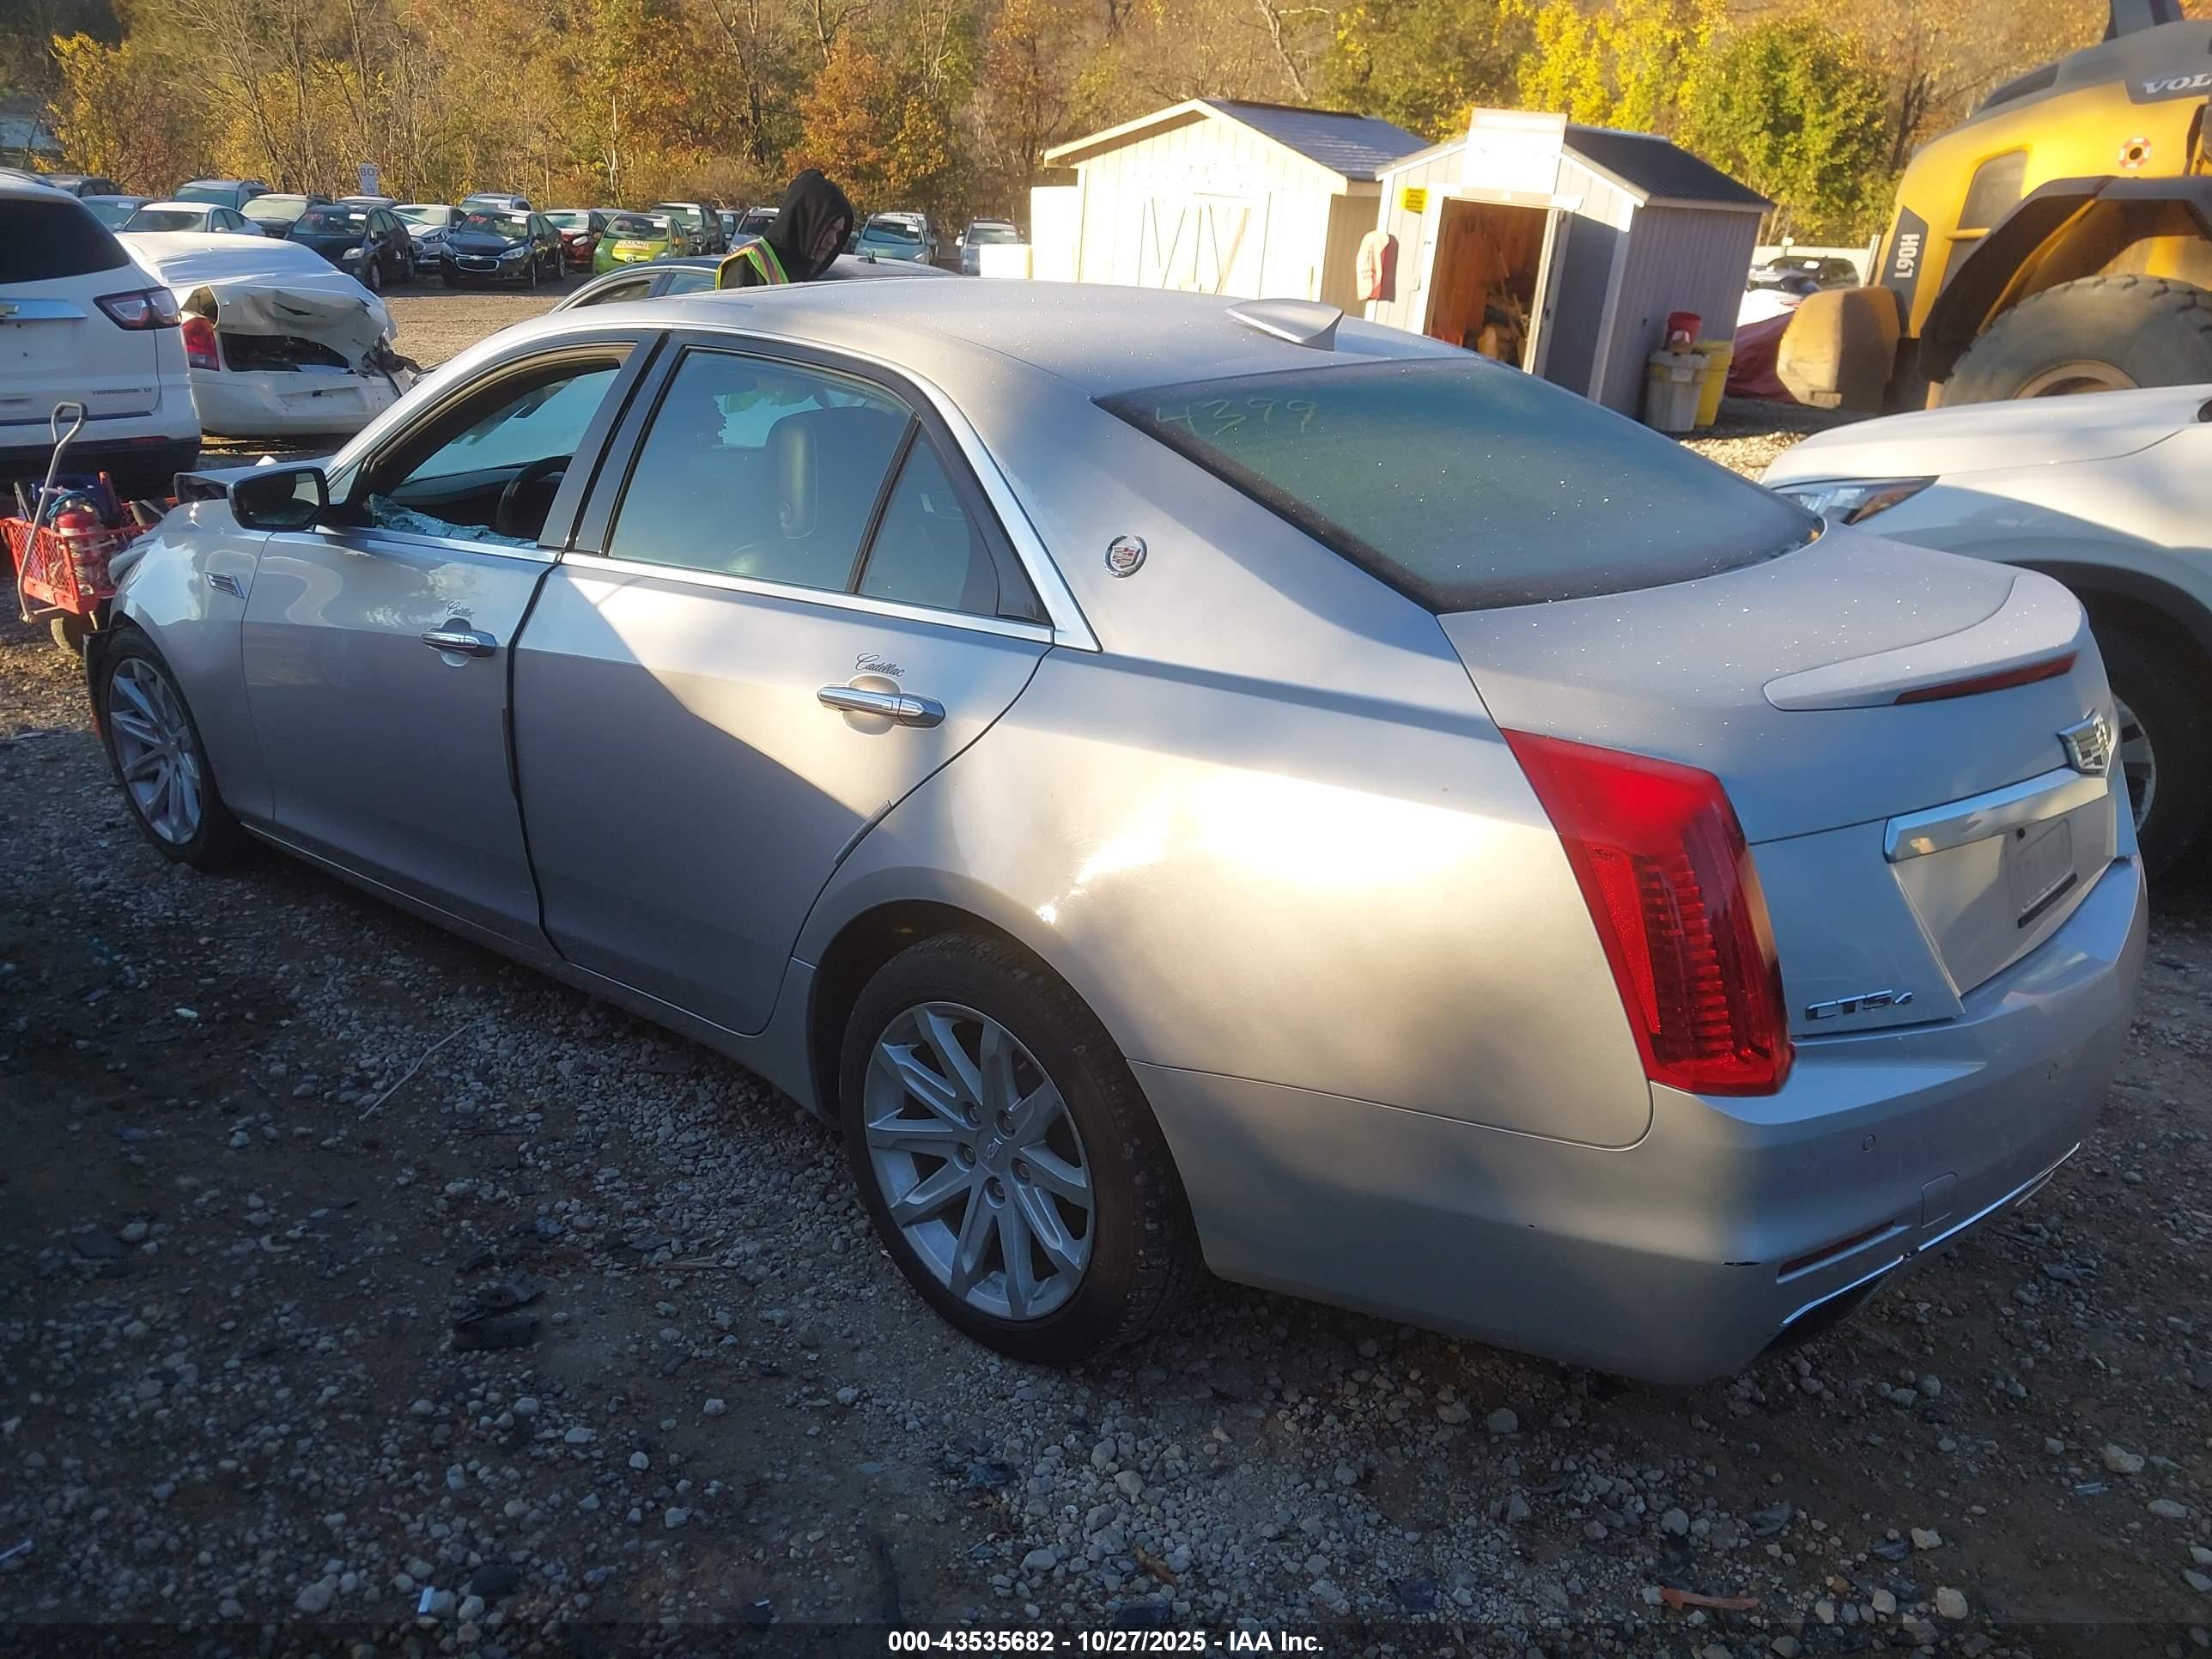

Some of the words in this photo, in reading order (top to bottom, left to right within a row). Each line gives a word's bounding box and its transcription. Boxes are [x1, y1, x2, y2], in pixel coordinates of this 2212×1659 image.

[2143, 74, 2212, 94] VOL
[1894, 233, 1921, 278] L90H
[1155, 398, 1319, 436] 4399
[854, 653, 907, 678] Cadillac
